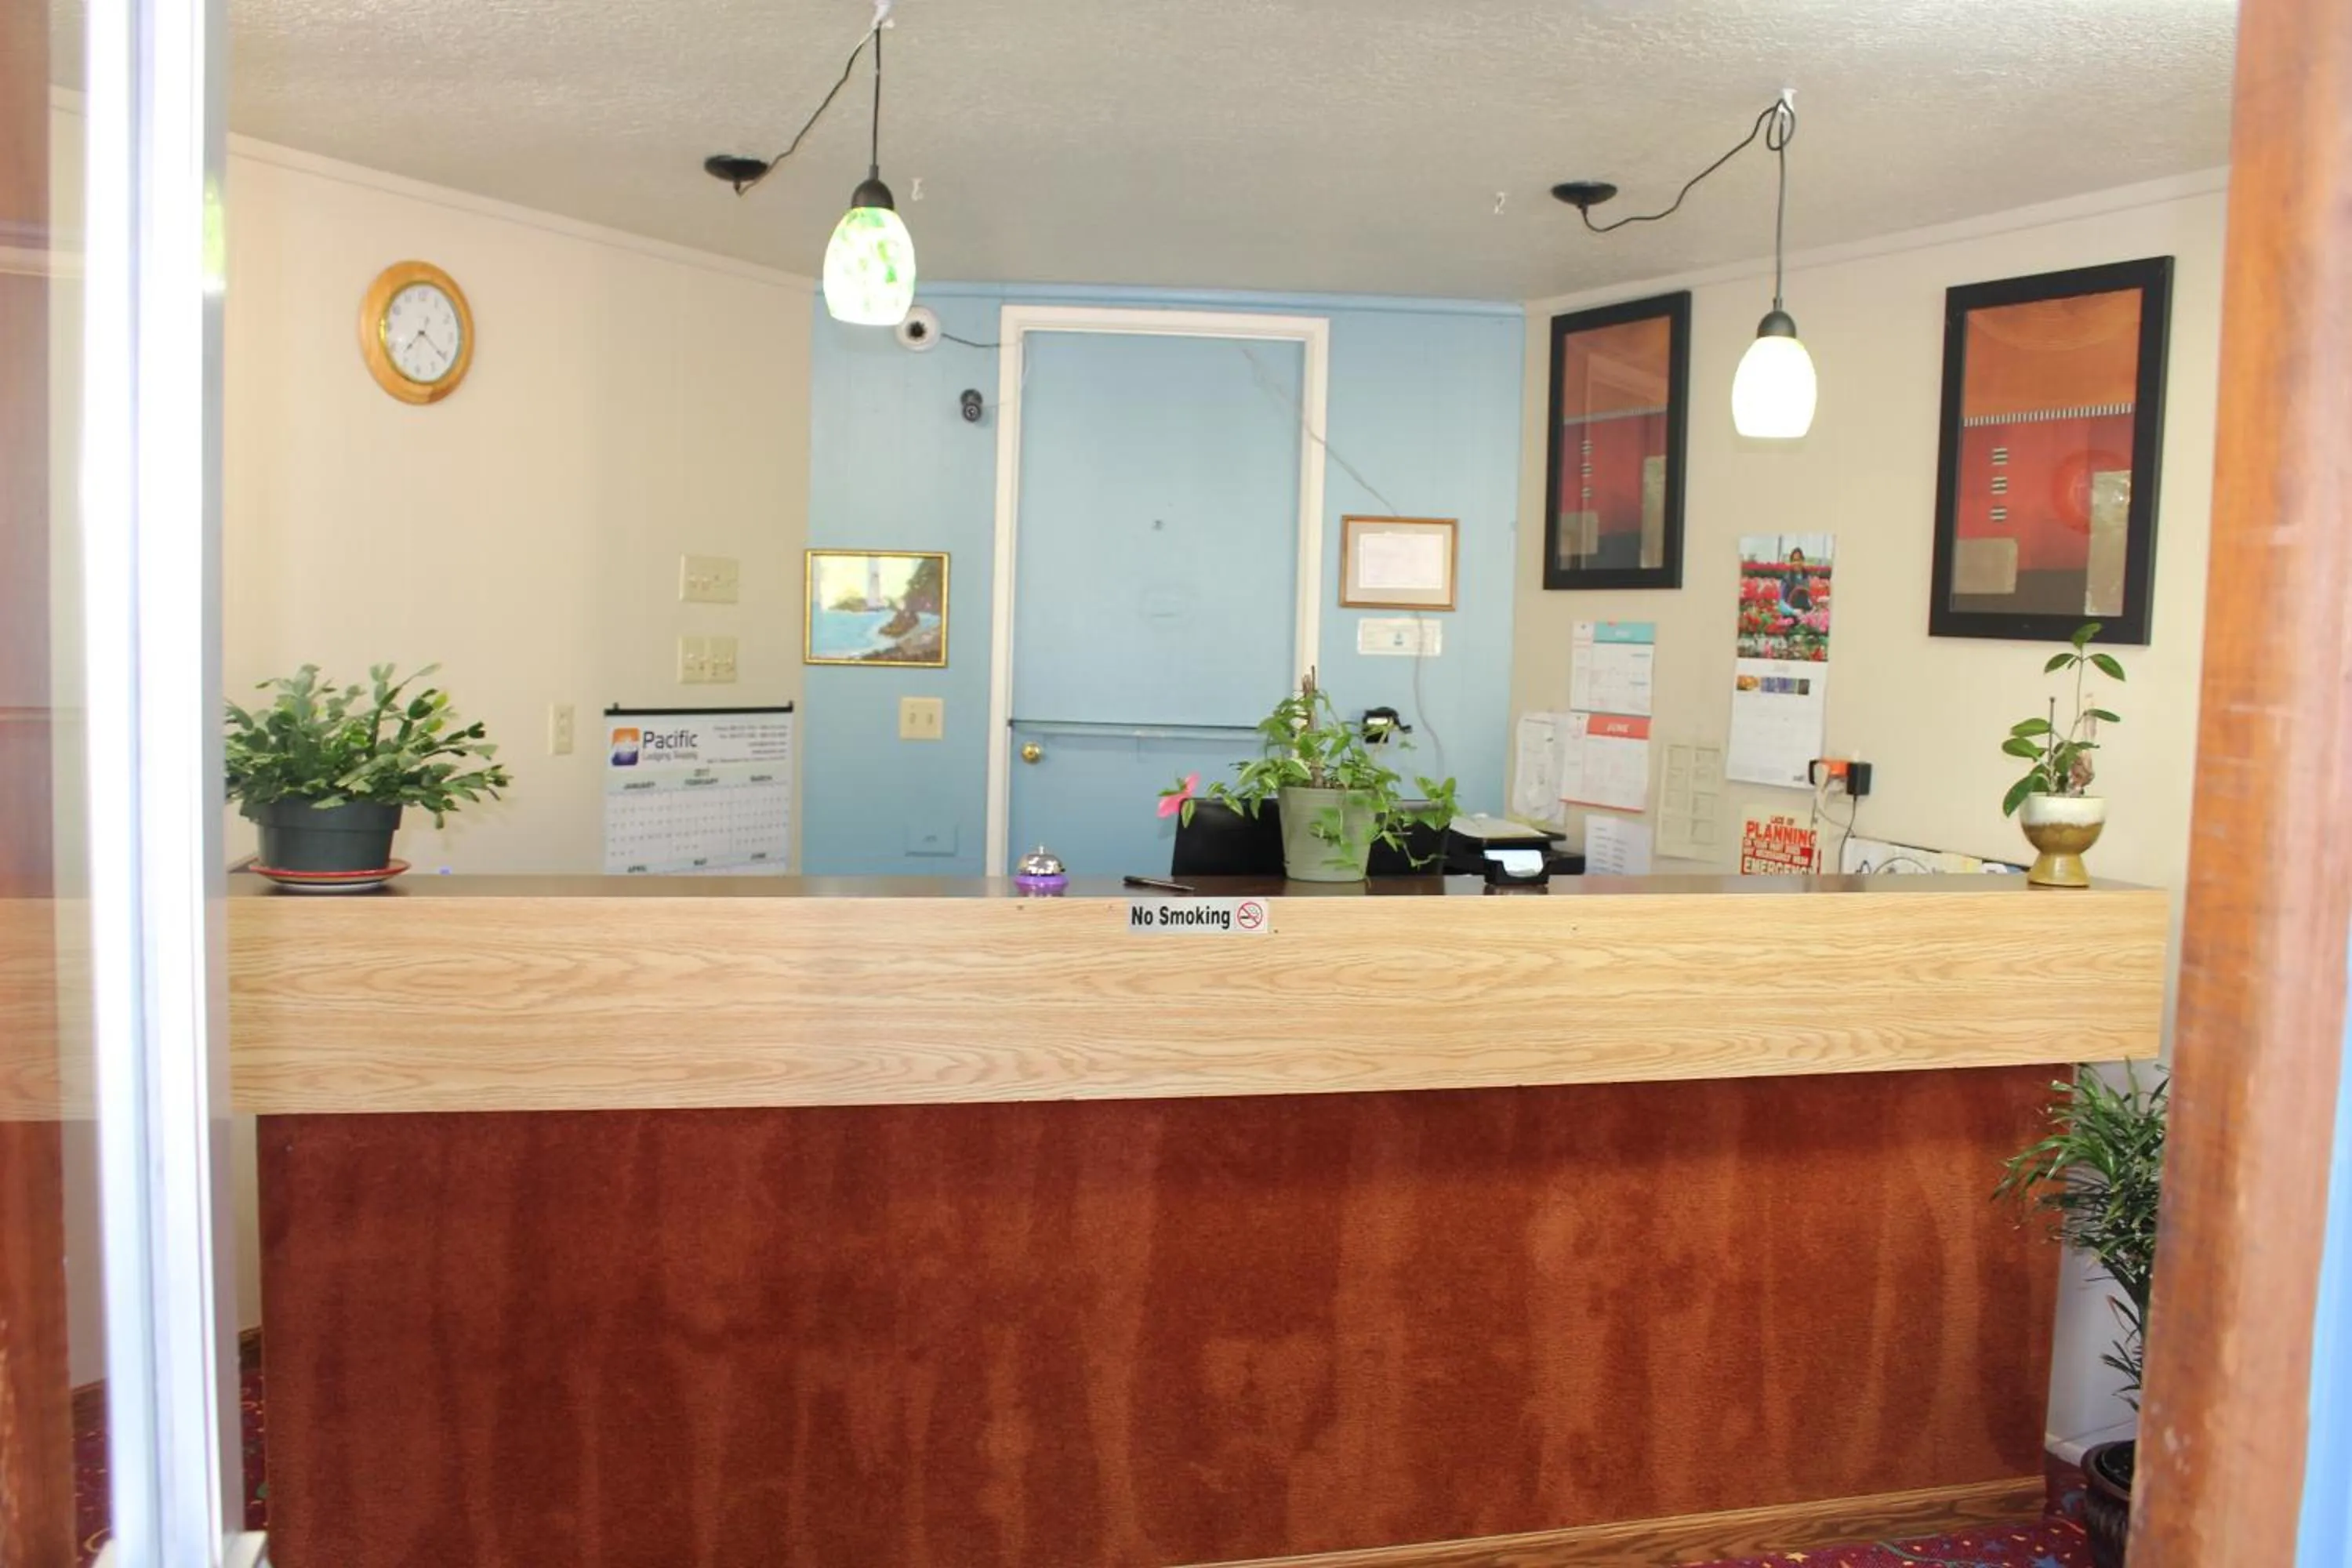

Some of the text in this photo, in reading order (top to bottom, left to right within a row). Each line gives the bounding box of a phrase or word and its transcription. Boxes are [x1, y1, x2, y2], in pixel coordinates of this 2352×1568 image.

[643, 729, 699, 750] Pacific
[1131, 905, 1231, 931] No Smoking
